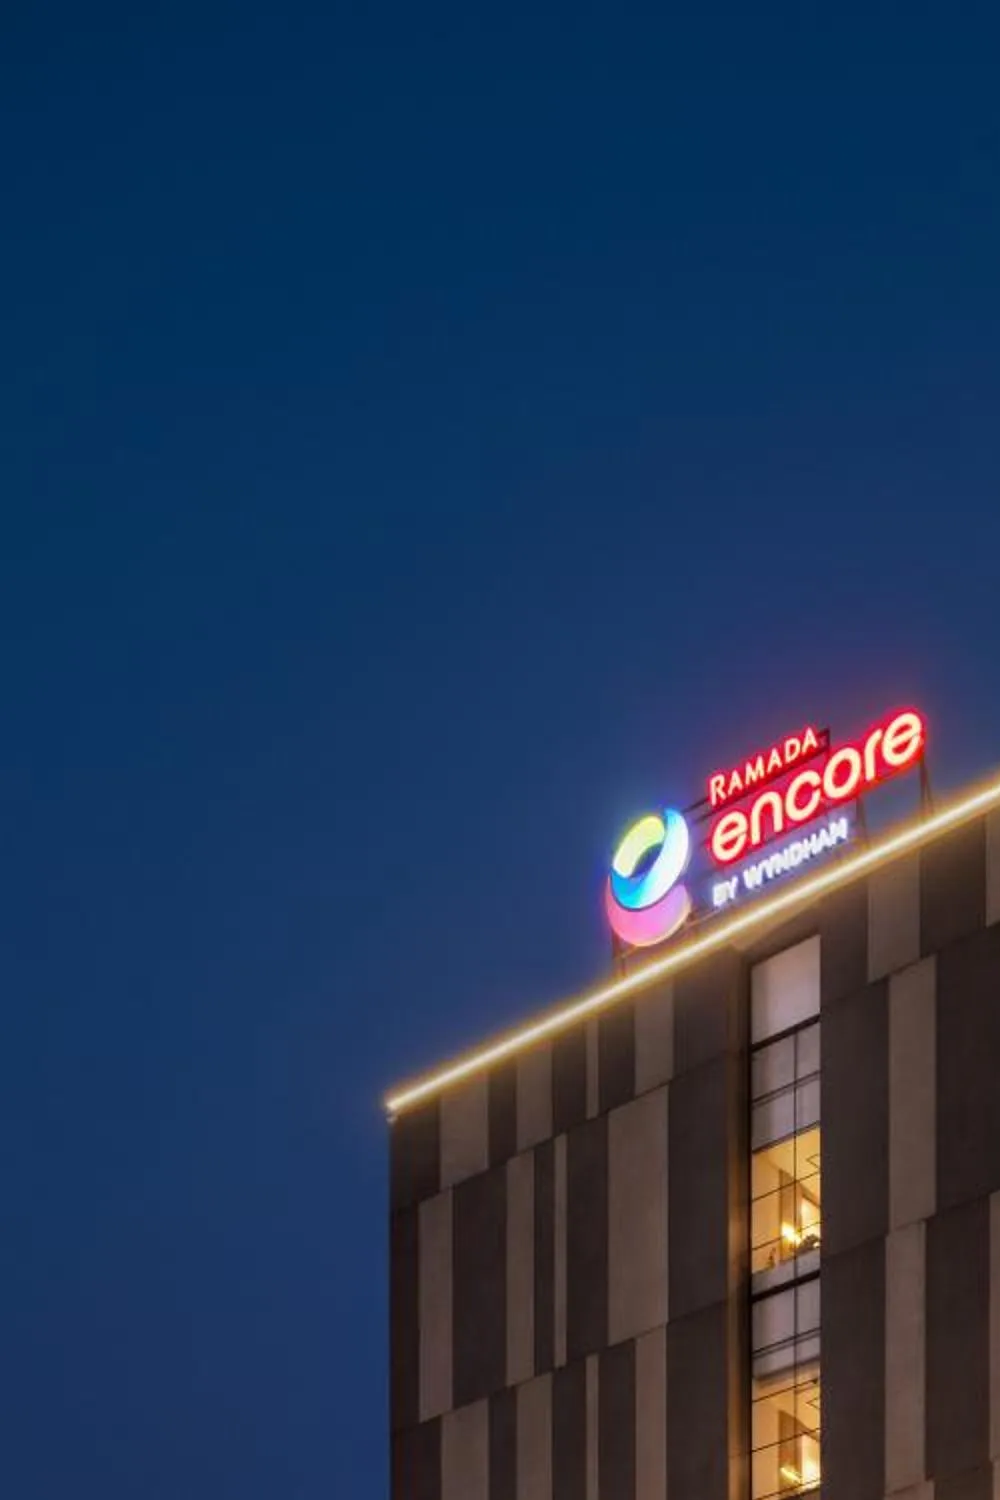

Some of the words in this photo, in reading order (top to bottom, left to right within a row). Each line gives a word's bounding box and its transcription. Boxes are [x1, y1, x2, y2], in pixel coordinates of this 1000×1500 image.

[710, 727, 820, 806] RAMADA
[711, 712, 923, 861] encore
[712, 876, 738, 906] BY
[743, 817, 847, 889] WYNDHAM
